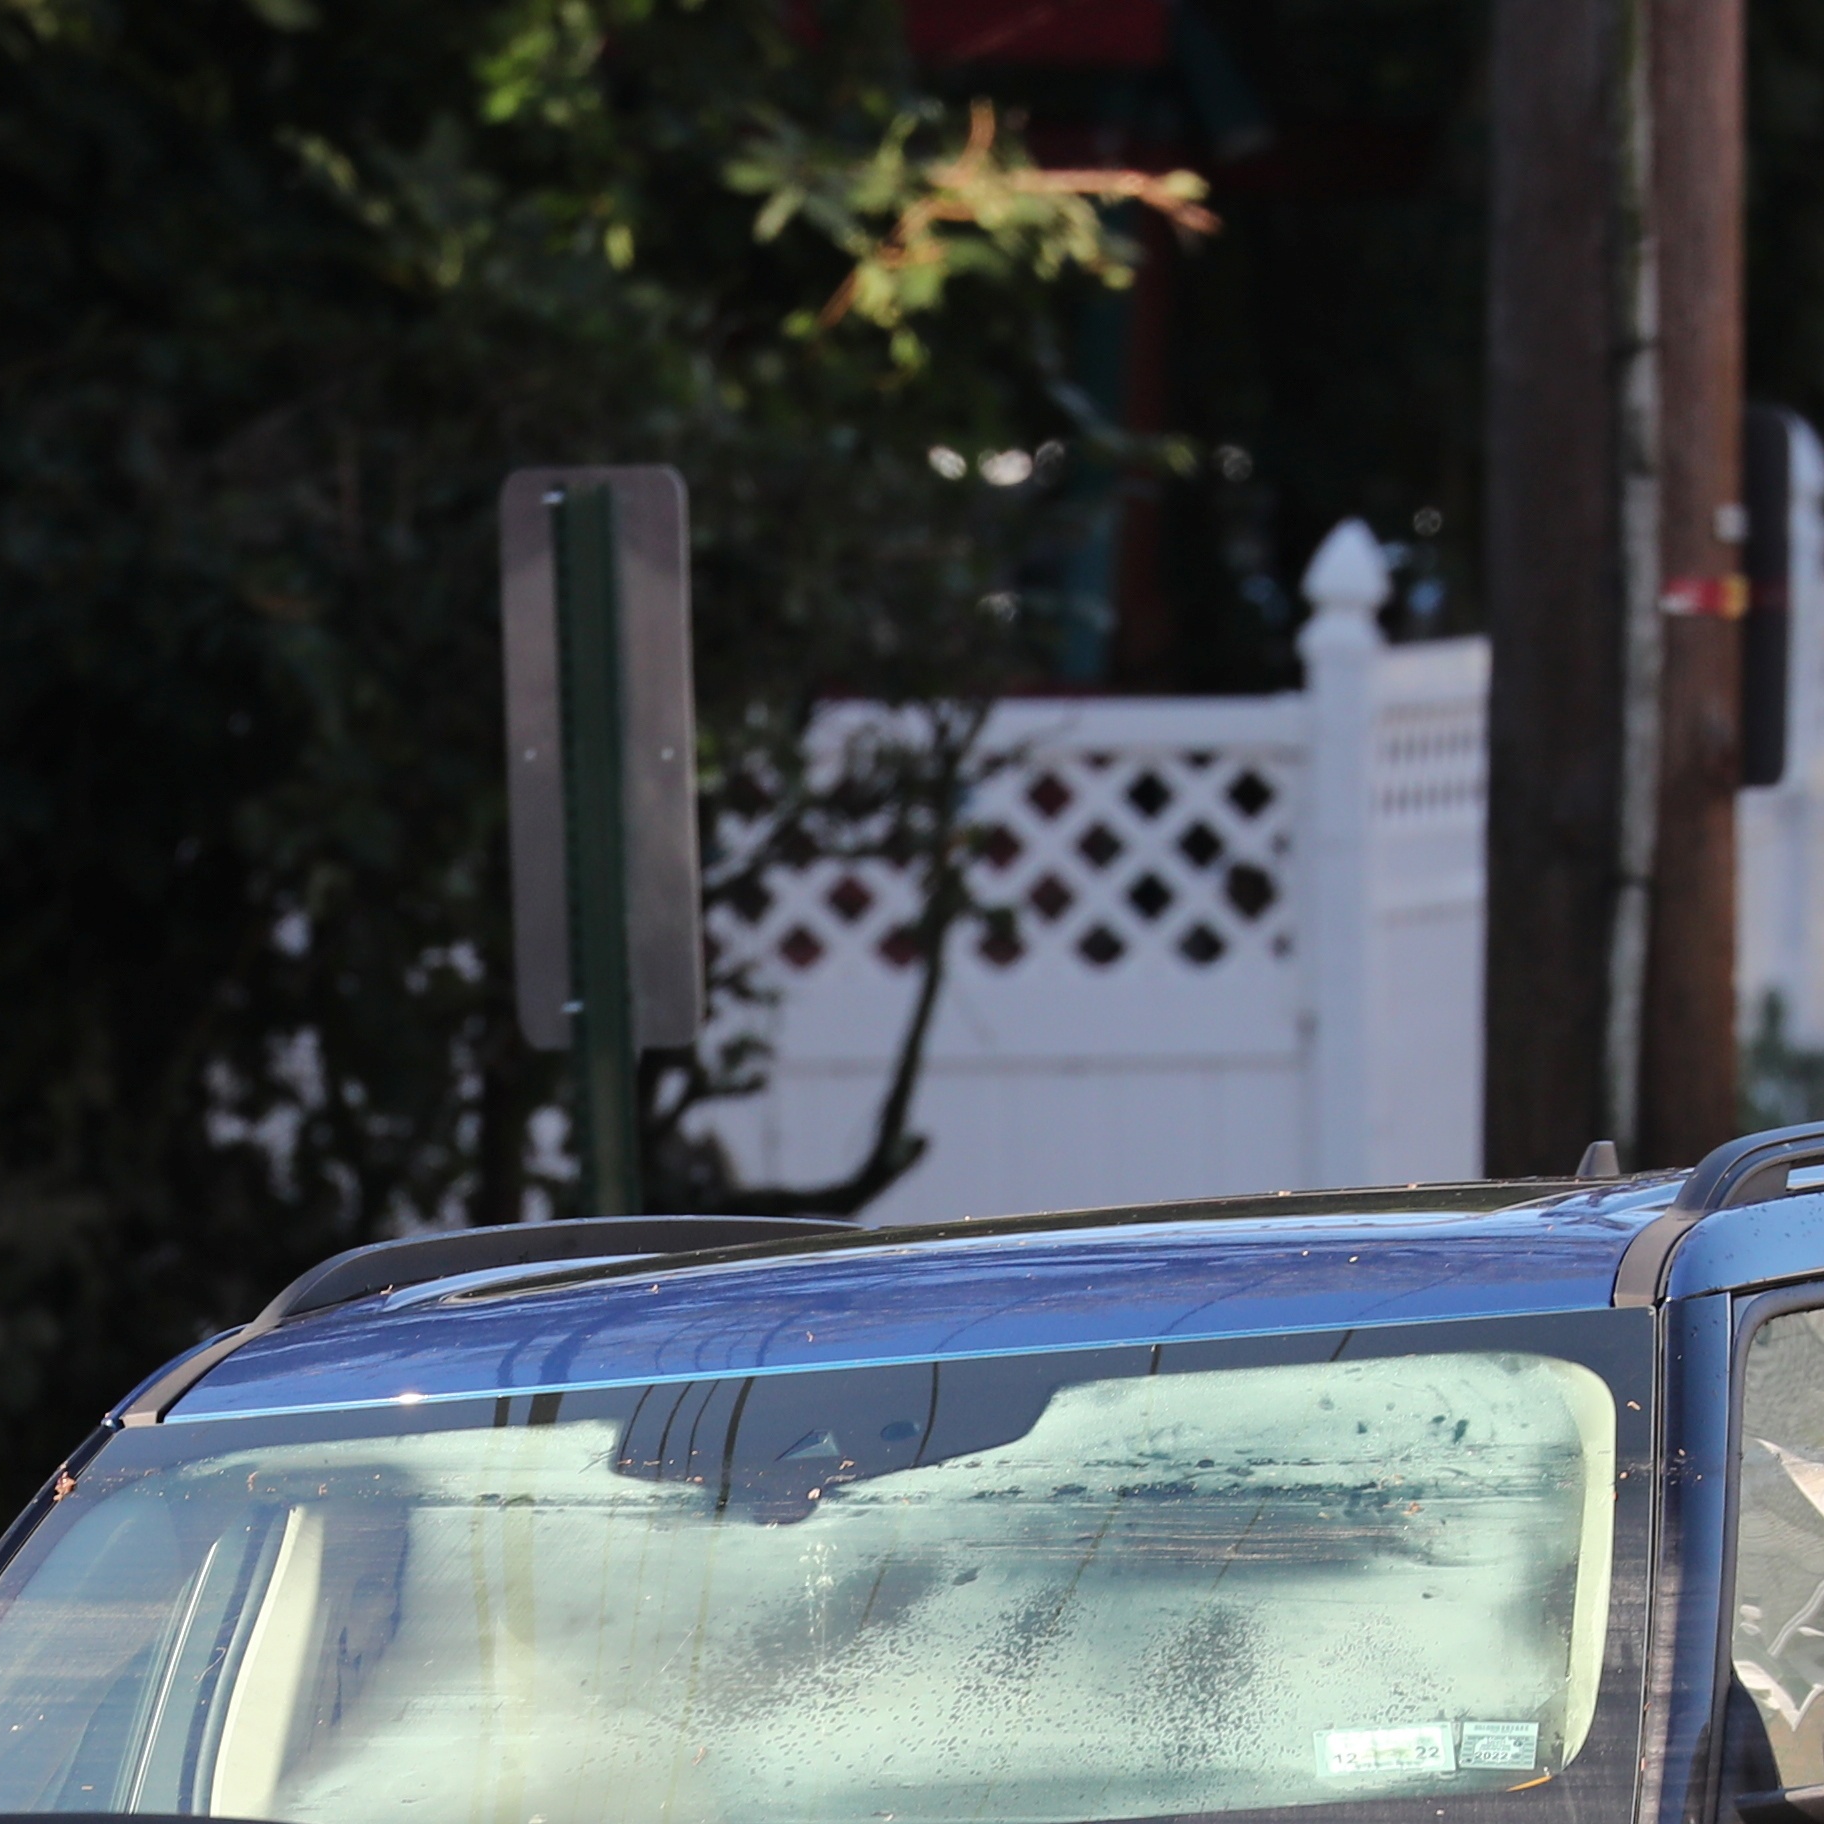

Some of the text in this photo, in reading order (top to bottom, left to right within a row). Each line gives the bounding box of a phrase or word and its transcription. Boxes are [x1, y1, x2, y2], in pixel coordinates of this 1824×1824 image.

[1333, 1753, 1358, 1764] 12
[1414, 1745, 1440, 1760] 22
[1474, 1751, 1509, 1760] 2022
